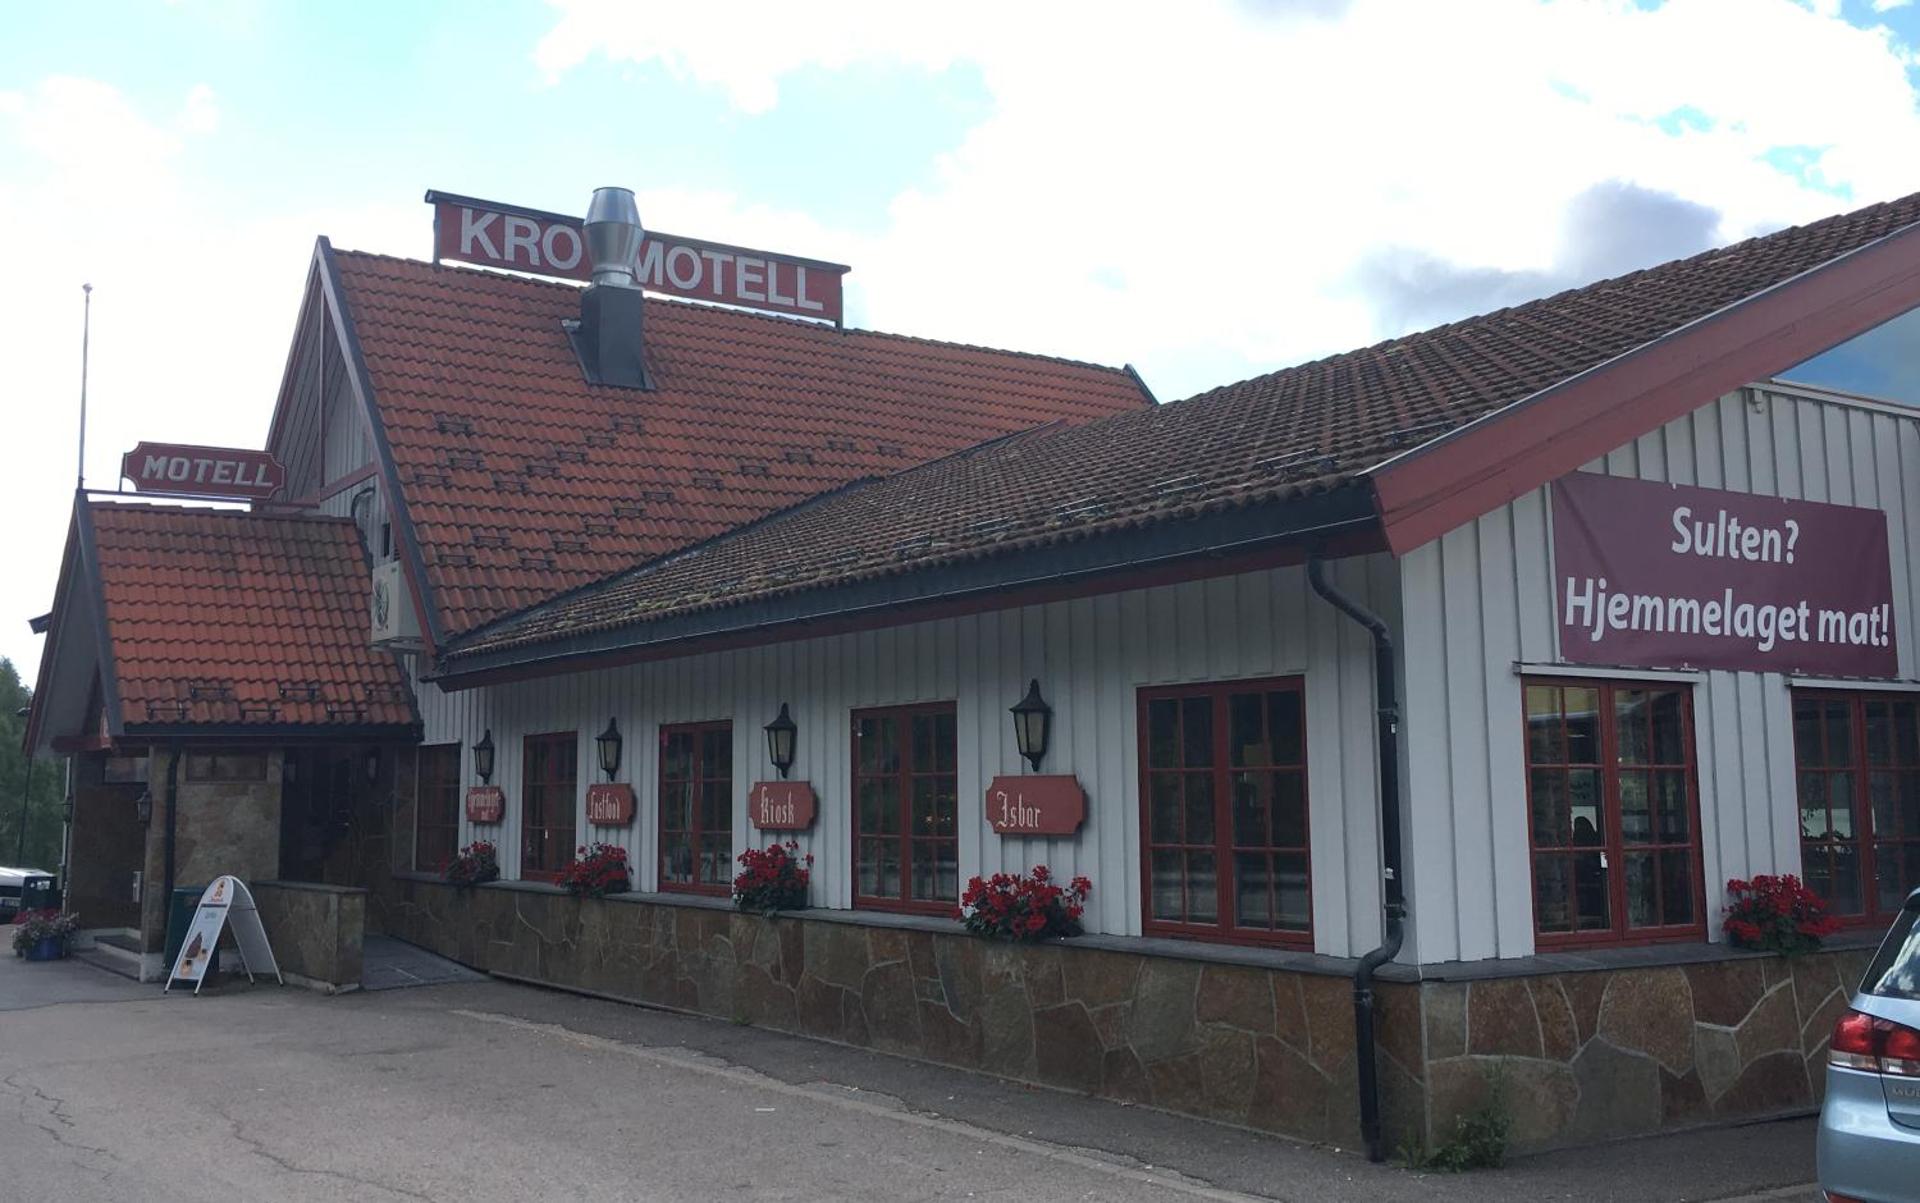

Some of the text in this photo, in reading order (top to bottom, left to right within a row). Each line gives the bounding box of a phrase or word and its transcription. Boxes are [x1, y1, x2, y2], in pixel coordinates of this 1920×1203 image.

[460, 208, 823, 311] KRO MOTELL
[142, 455, 273, 487] MOTELL
[1672, 506, 1799, 564] Sulten?
[1565, 576, 1889, 651] Hjemmelaget mat!
[760, 786, 794, 824] Kiosk
[996, 791, 1041, 828] Isbar
